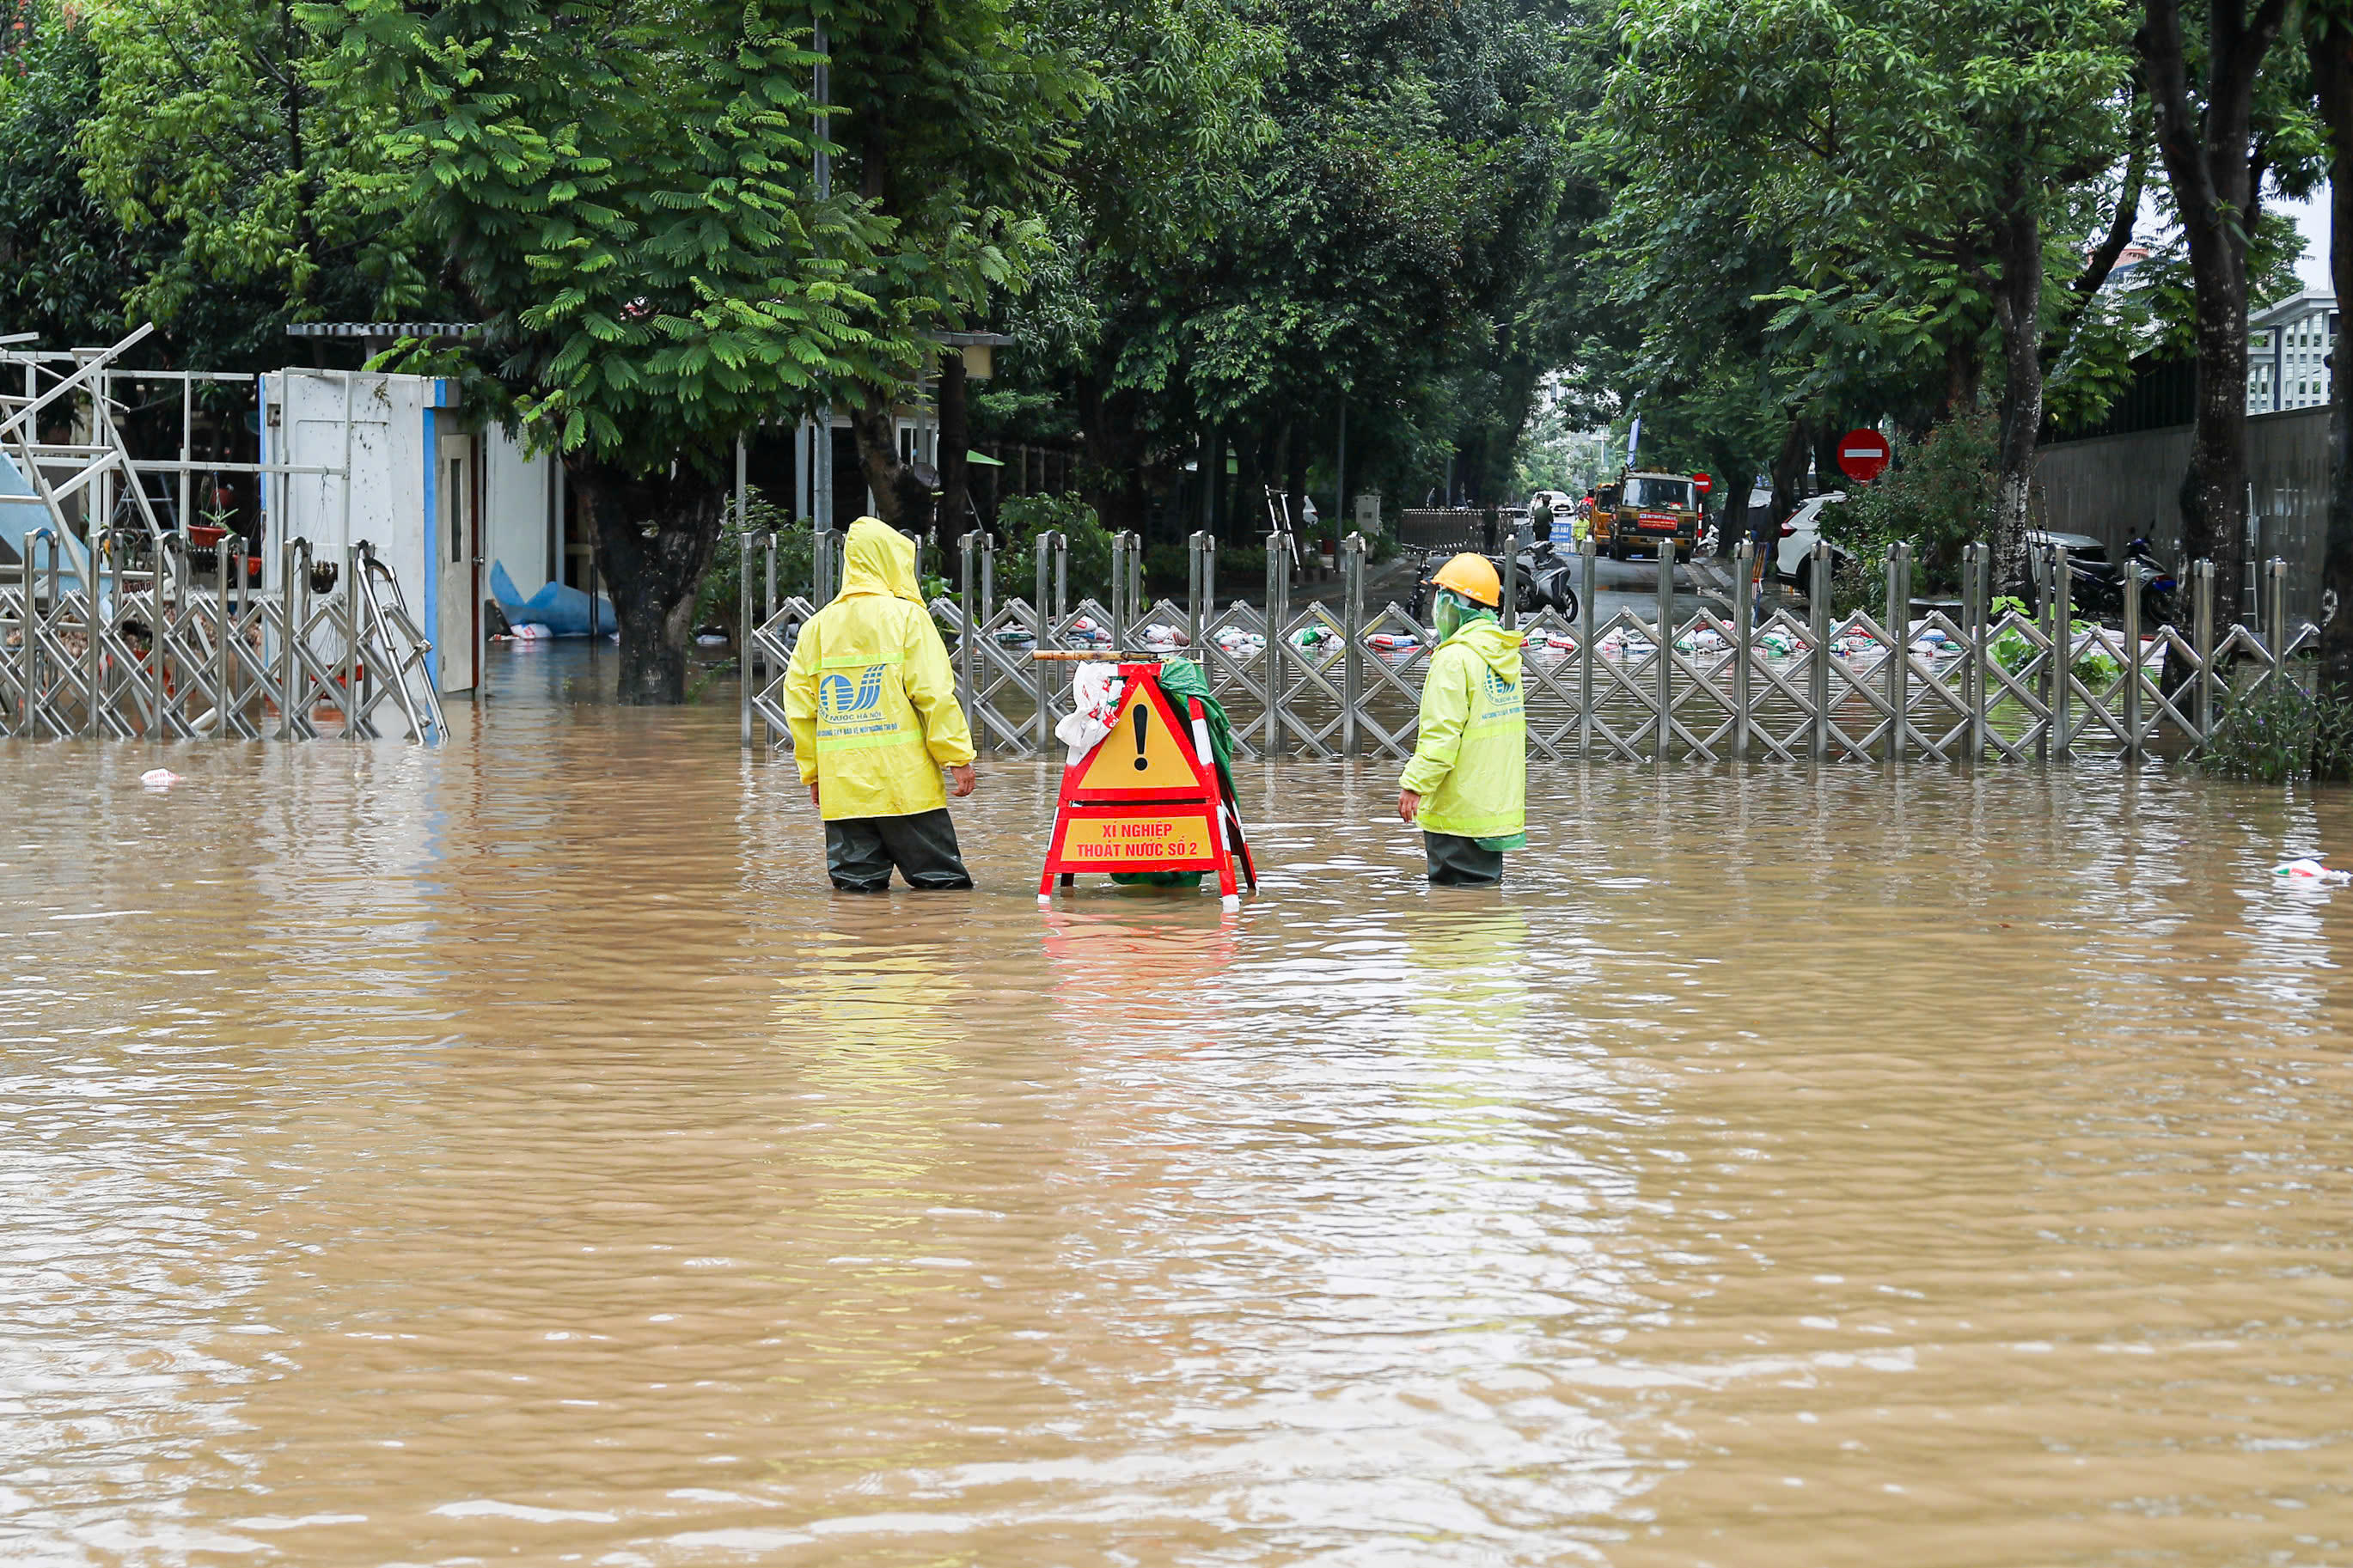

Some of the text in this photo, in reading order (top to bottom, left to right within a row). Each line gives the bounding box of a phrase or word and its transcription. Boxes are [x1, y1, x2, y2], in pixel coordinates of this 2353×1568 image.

[1103, 821, 1172, 839] XÍ NGHIỆP
[1077, 836, 1197, 857] THOÁT NƯỚC SỐ 2
